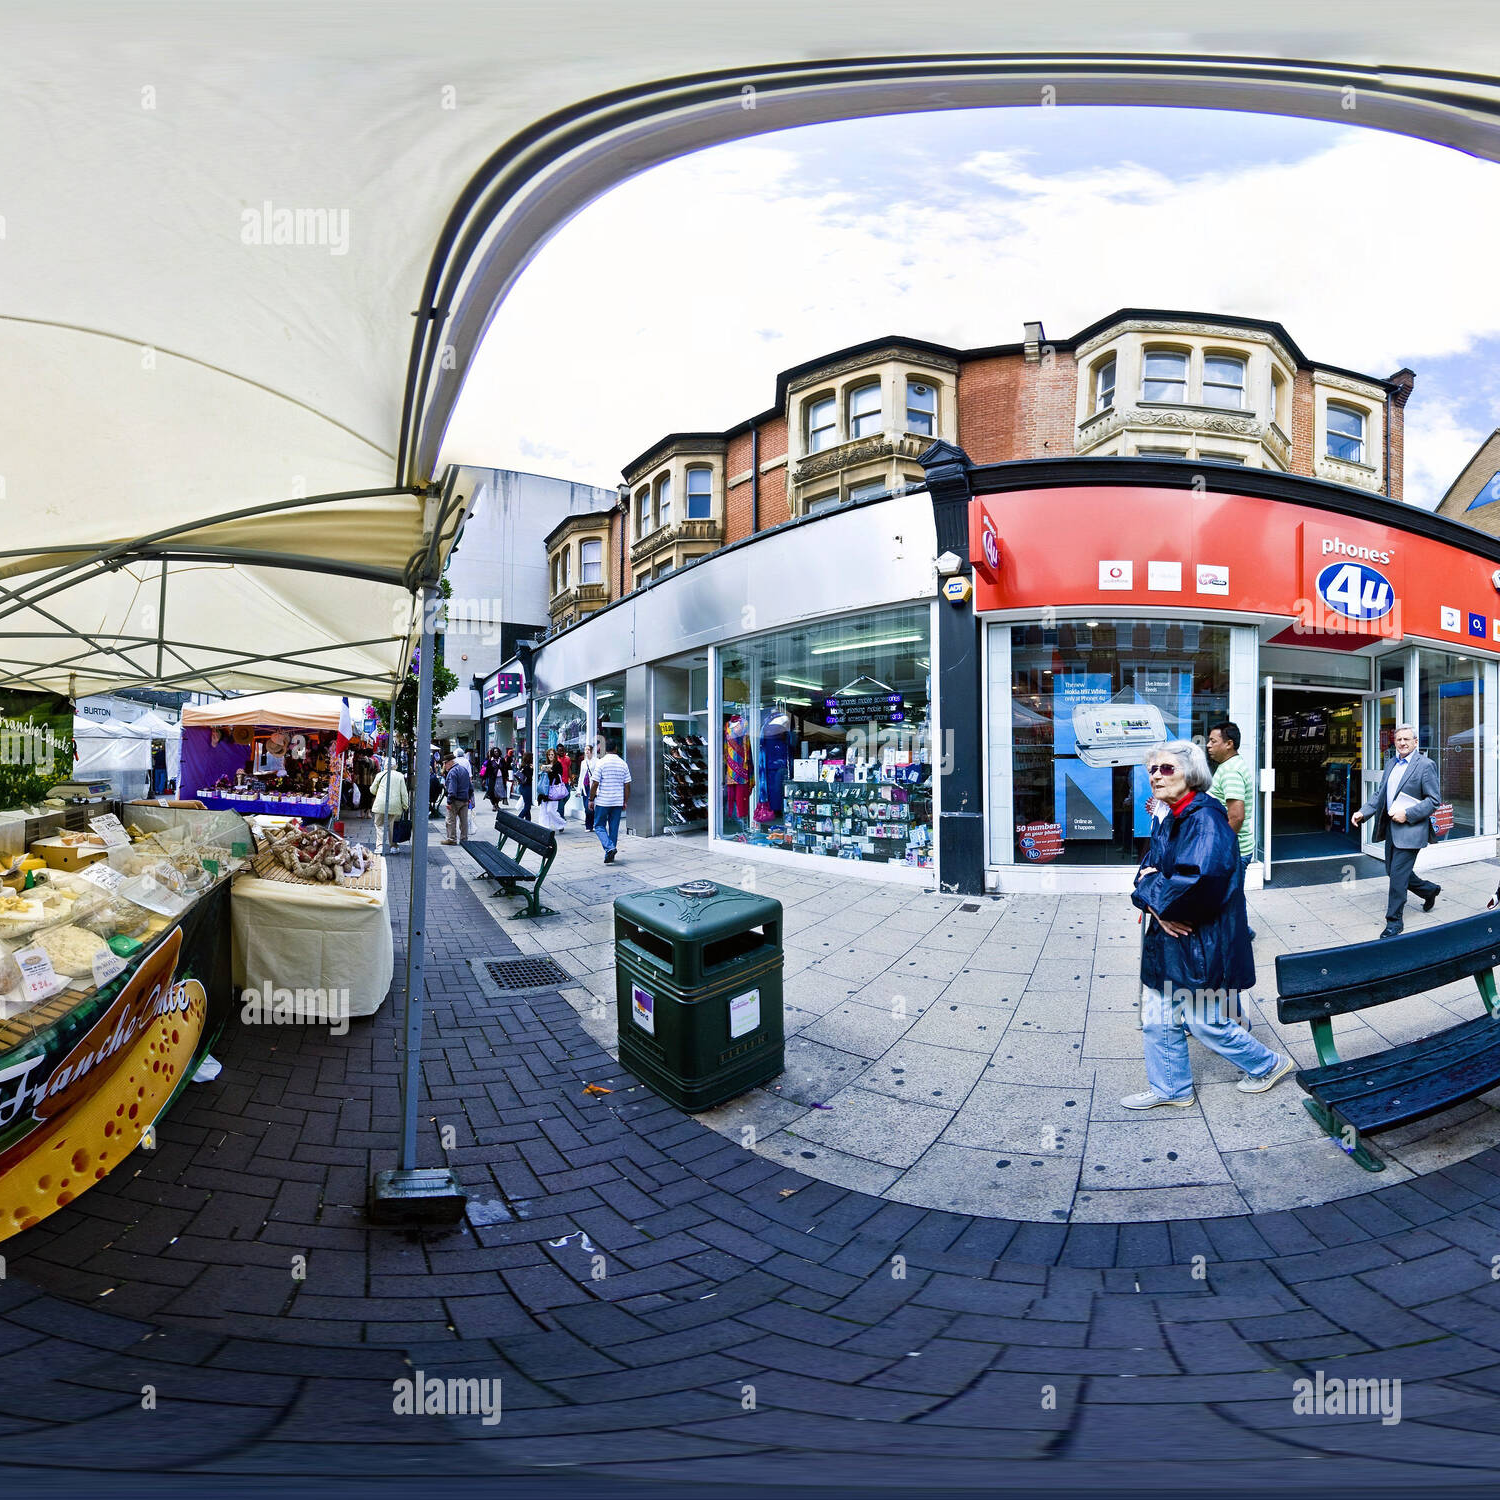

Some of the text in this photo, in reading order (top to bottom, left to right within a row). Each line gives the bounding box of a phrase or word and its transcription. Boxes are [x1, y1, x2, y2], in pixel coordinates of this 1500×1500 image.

[1322, 537, 1390, 564] phones
[1327, 565, 1388, 615] 4u
[84, 706, 111, 716] BURTON
[1028, 823, 1061, 831] numbers
[720, 1035, 766, 1063] LITTER
